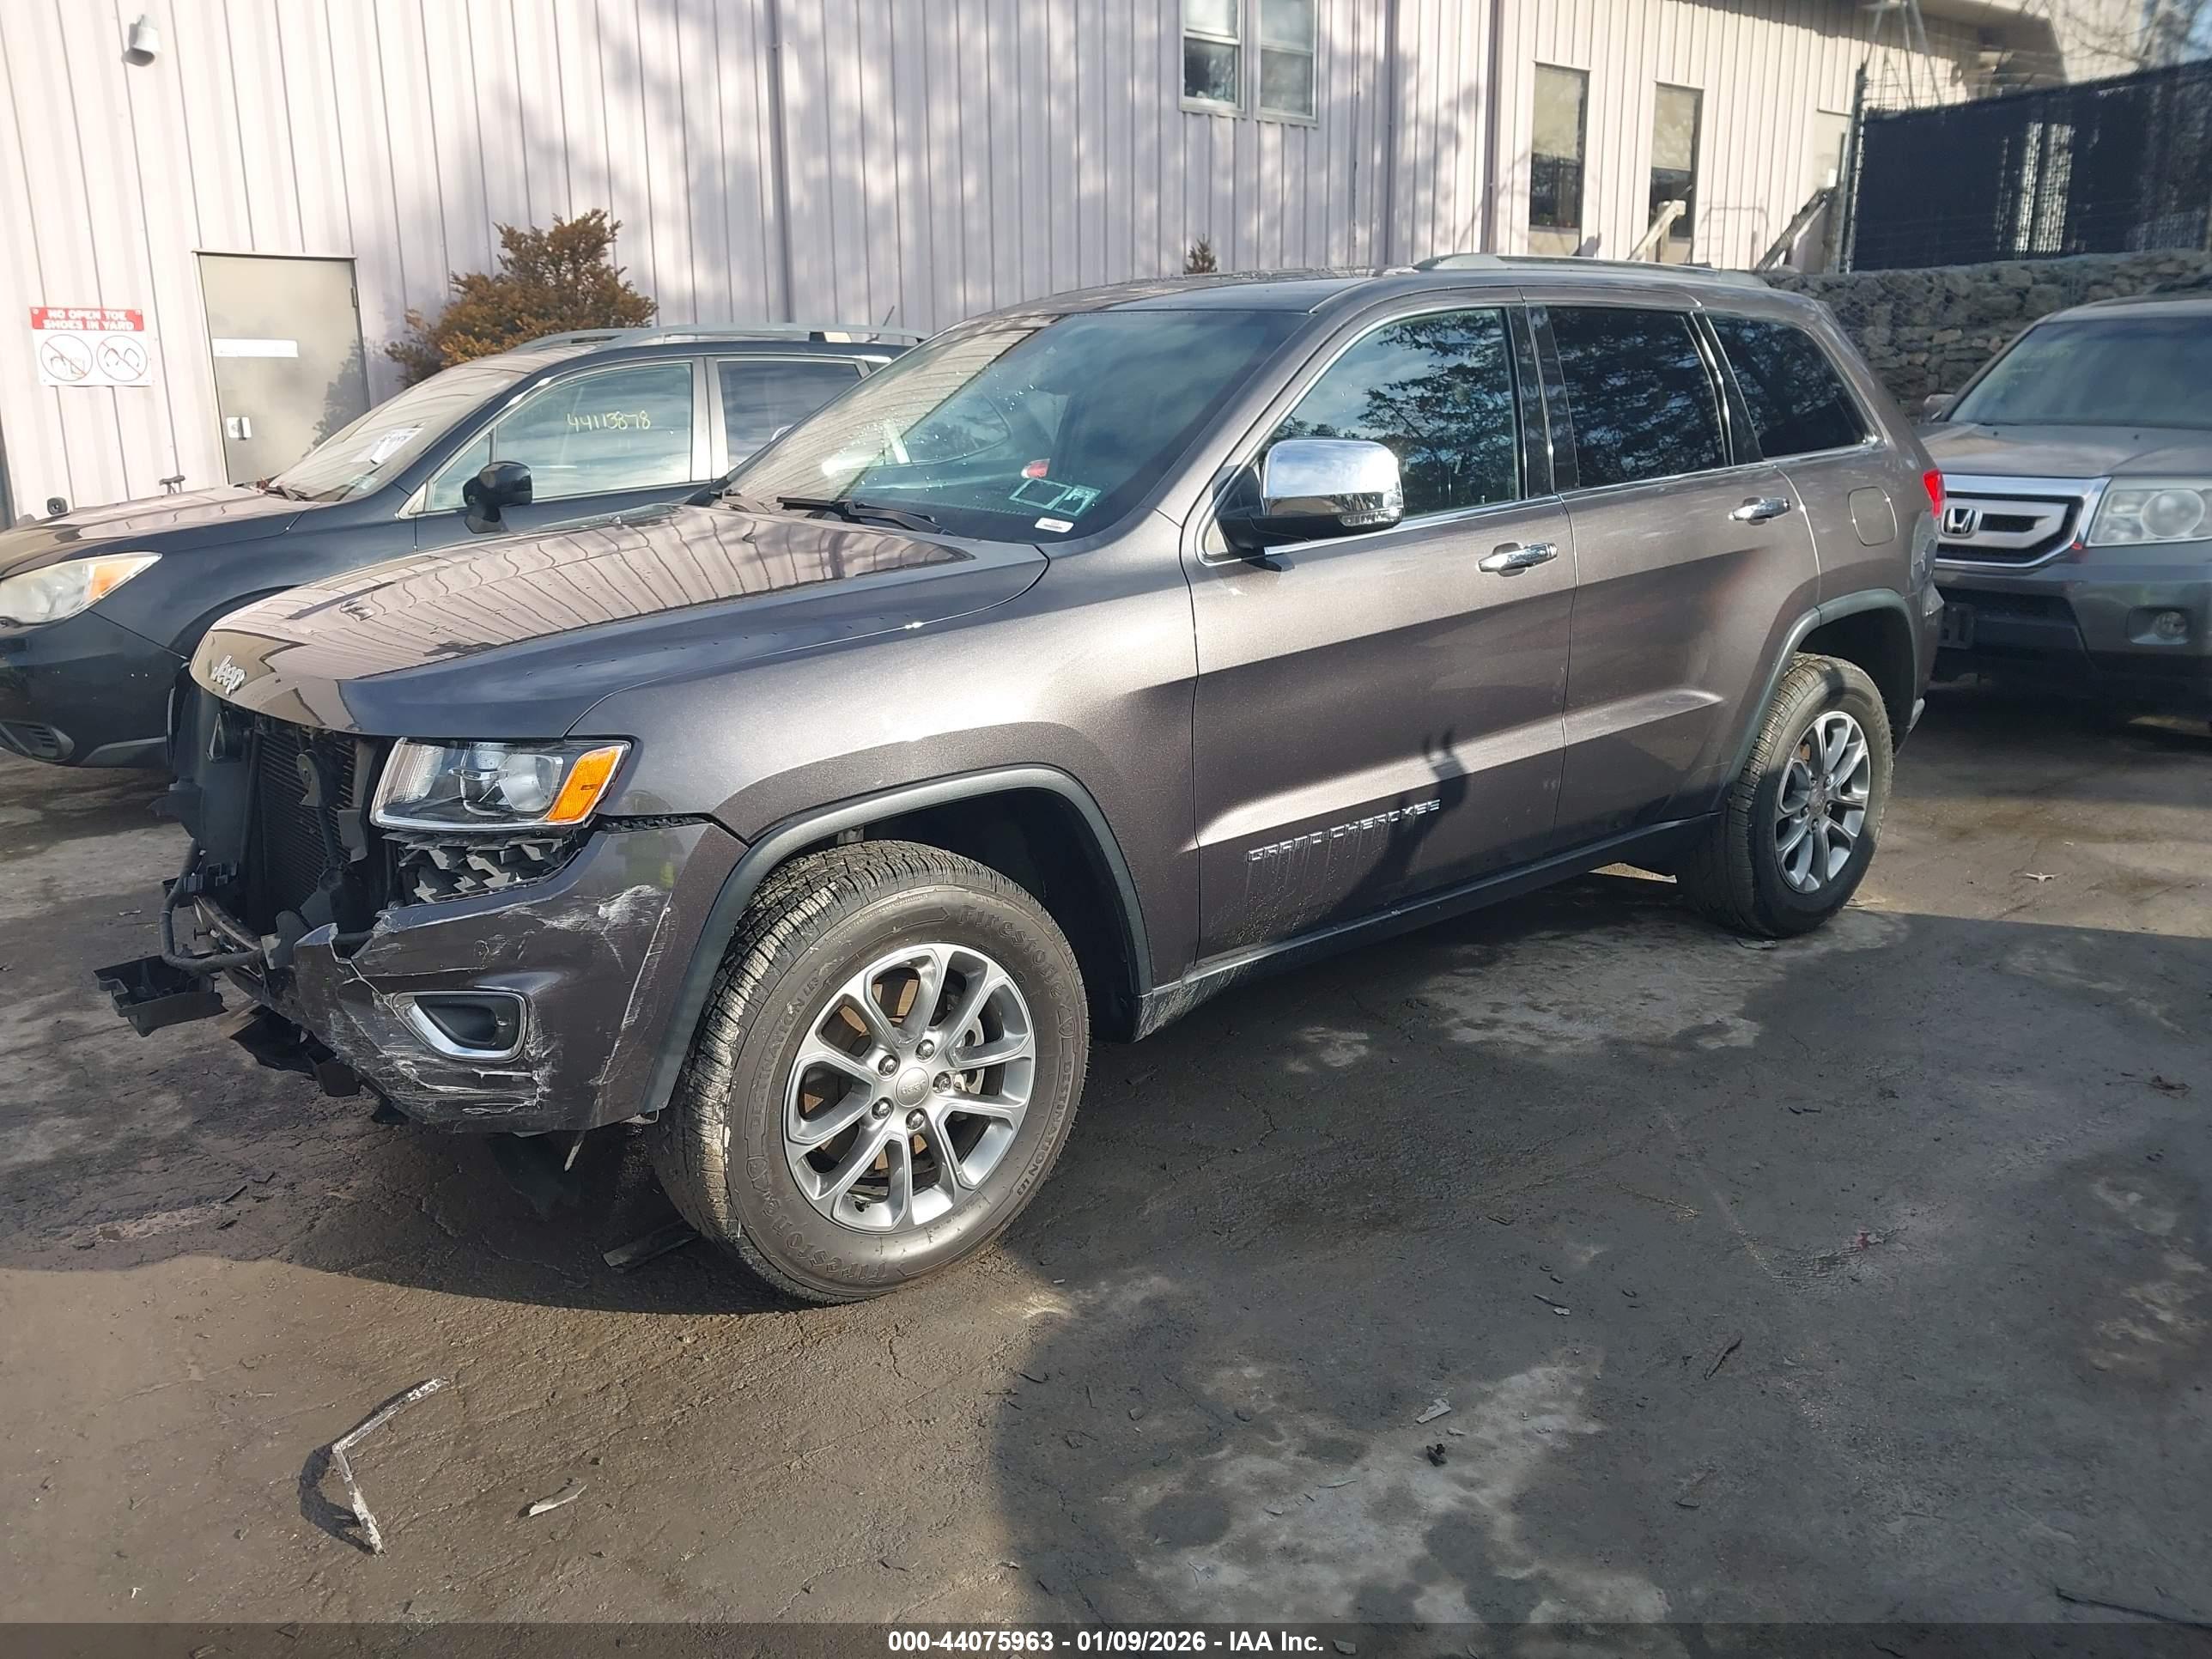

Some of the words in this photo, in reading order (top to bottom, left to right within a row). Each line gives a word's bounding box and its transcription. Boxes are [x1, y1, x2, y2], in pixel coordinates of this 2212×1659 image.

[43, 319, 83, 330] SHOES
[86, 320, 100, 331] IN
[102, 320, 135, 331] YARD
[47, 309, 66, 319] NO
[68, 310, 102, 320] OPEN
[103, 310, 126, 321] TOE
[567, 410, 651, 432] 44113878
[210, 654, 246, 696] Jeep
[1248, 831, 1323, 862] GRAND
[1330, 799, 1441, 840] CHEROKEE
